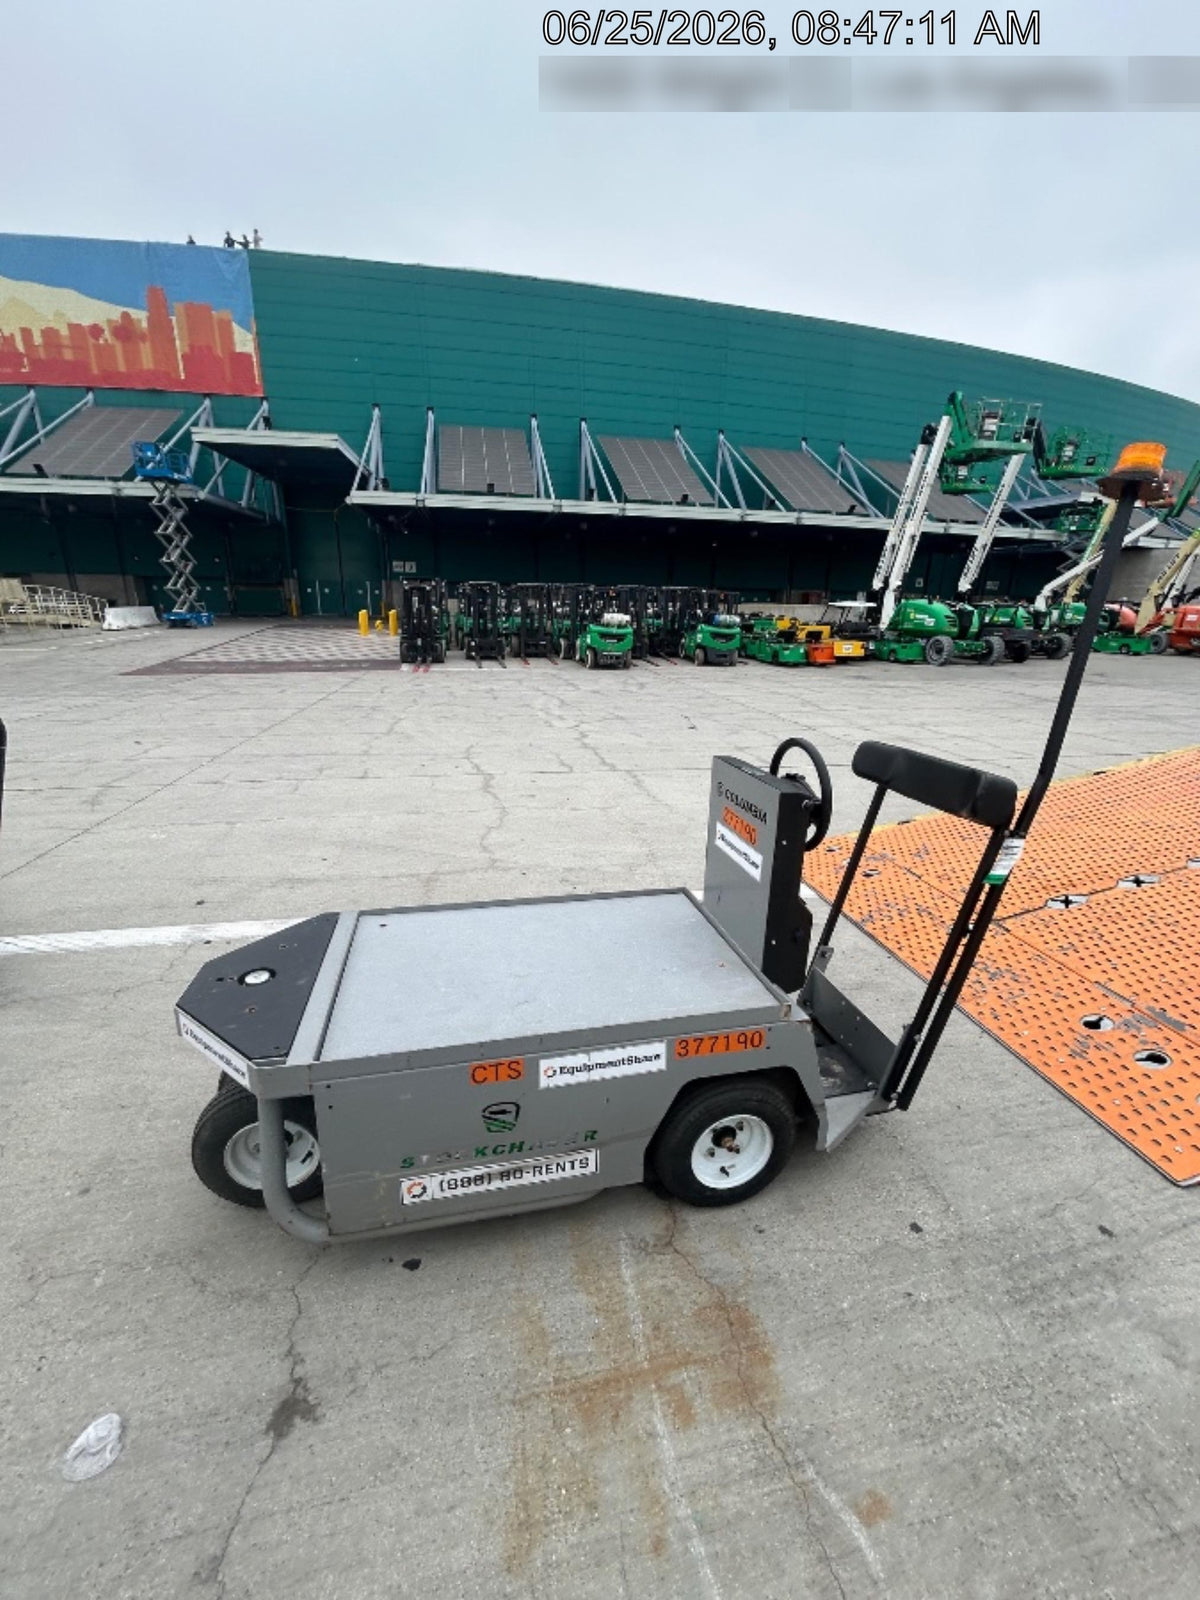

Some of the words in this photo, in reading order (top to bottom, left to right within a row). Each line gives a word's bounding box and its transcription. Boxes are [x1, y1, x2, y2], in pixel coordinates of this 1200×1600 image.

[676, 1030, 763, 1058] 377190
[470, 1059, 523, 1085] CTS
[558, 1052, 662, 1077] EquipmentShare
